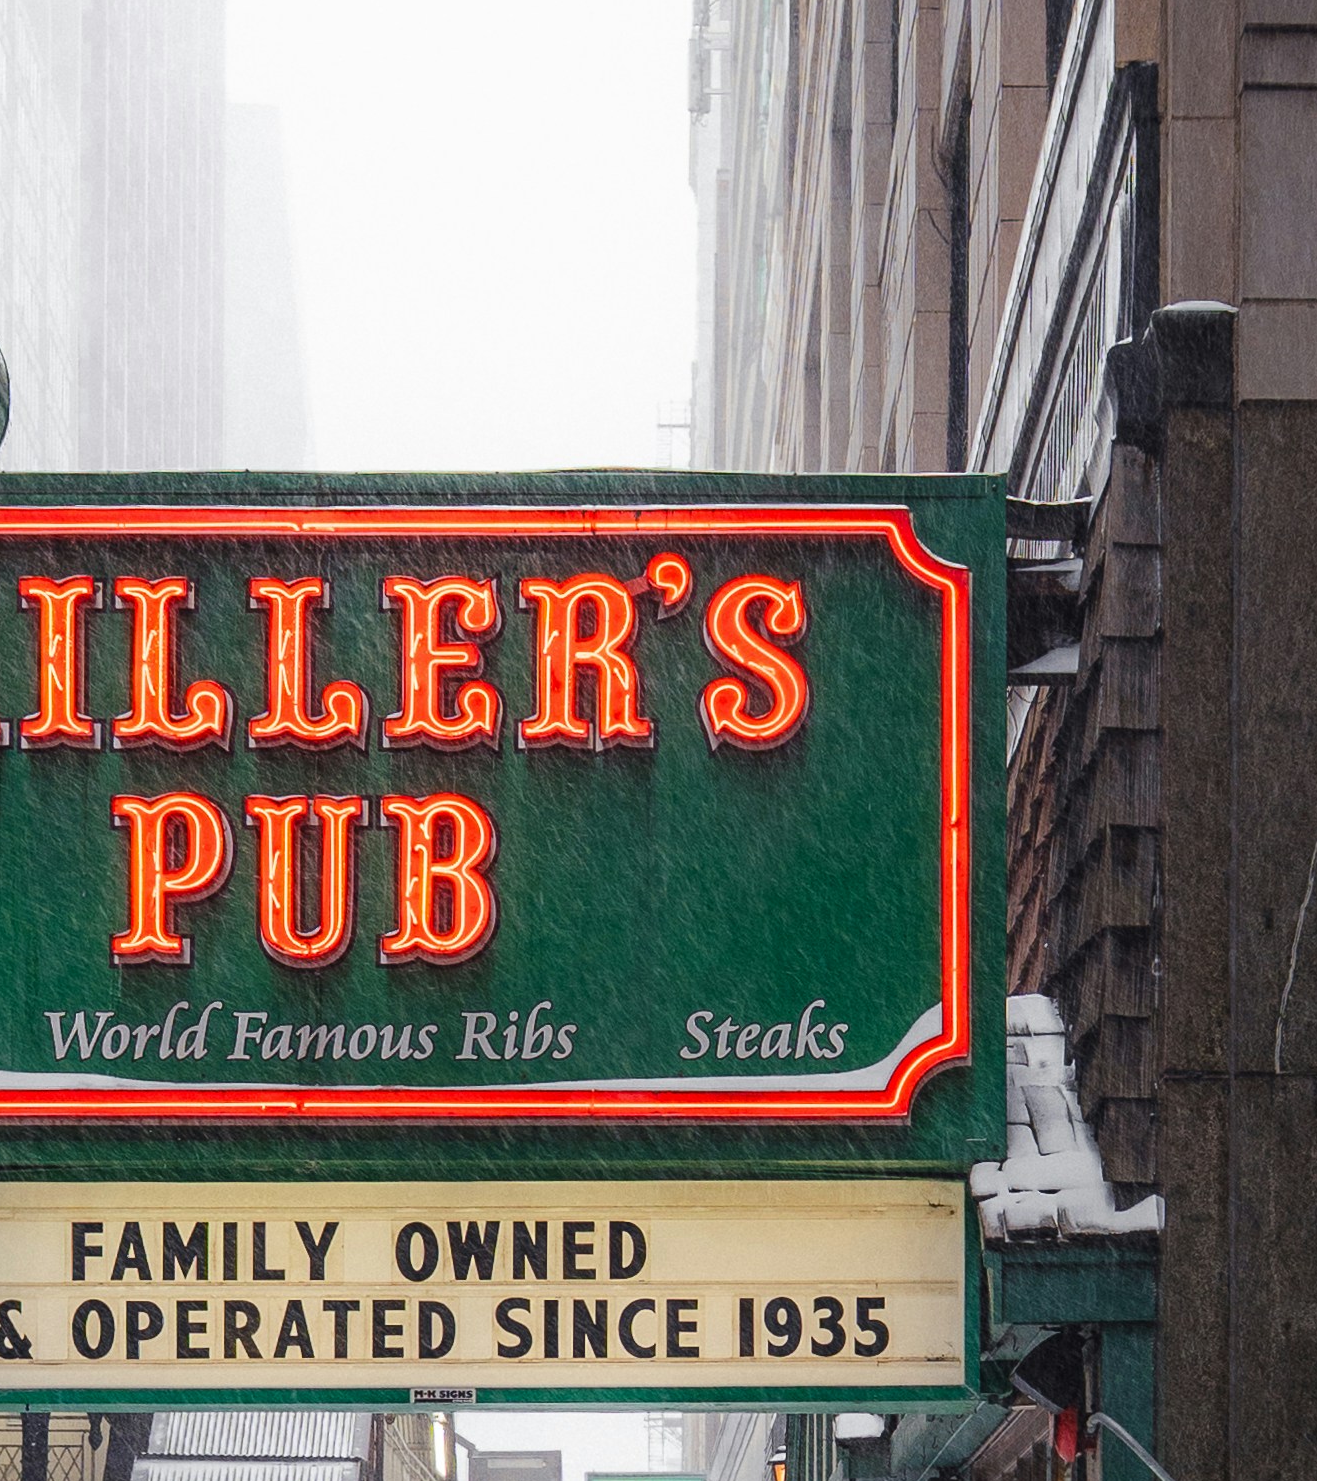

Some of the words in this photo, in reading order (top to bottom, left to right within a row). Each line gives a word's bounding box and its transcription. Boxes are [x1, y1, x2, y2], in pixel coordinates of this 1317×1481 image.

[111, 792, 495, 962] PUB
[44, 1000, 223, 1061] World
[226, 1010, 439, 1061] Famous
[454, 1000, 578, 1061] Ribs
[679, 999, 849, 1060] Steaks
[70, 1221, 340, 1281] FAMILY
[395, 1220, 647, 1281] OWNED
[71, 1299, 457, 1360] OPERATED
[495, 1297, 700, 1359] SINCE
[738, 1296, 890, 1358] 1935
[439, 1390, 473, 1398] SIGNS
